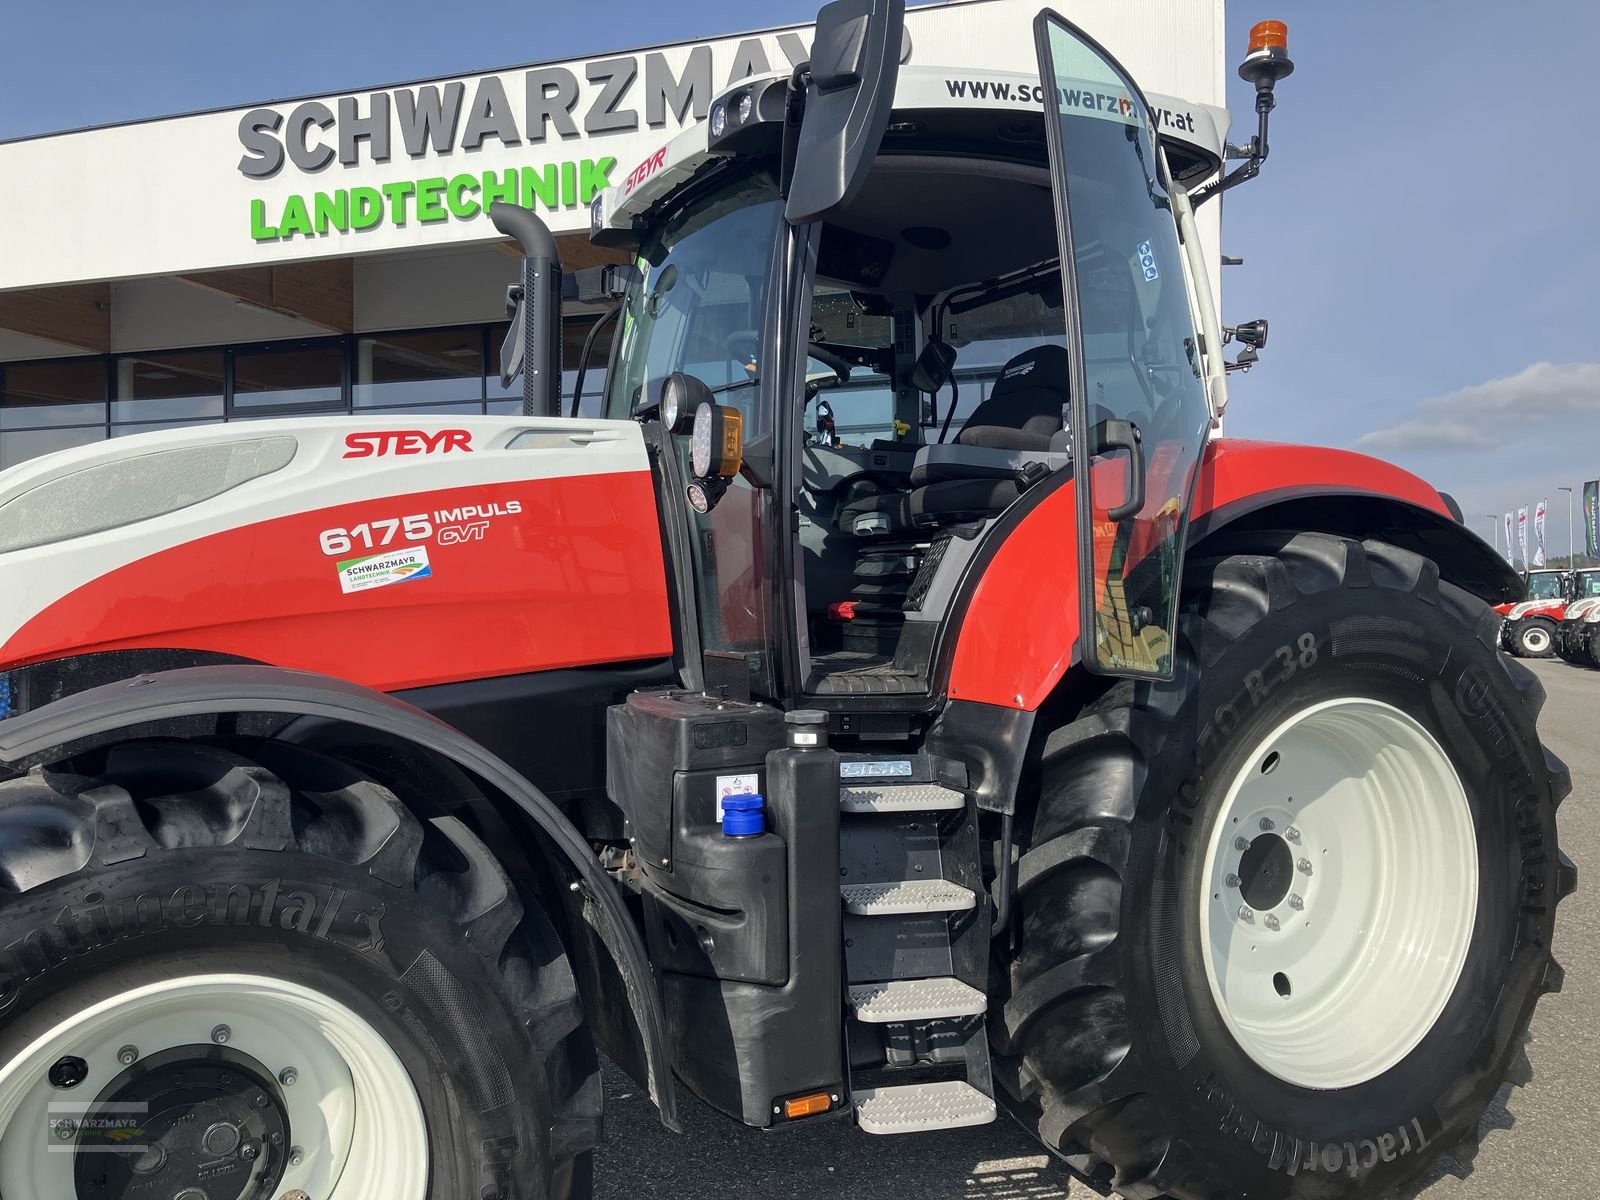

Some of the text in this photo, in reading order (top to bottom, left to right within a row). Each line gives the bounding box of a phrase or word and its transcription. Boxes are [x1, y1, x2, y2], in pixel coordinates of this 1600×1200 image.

[237, 23, 912, 181] SCHWARZMA
[624, 146, 667, 197] STEYR
[251, 155, 617, 242] LANDTECHNIK
[342, 429, 474, 459] STEYR
[319, 500, 523, 557] 6175 IMPULS
[437, 520, 490, 546] CVT
[346, 556, 416, 576] SCHWARZMAYR
[1275, 632, 1318, 682] 38
[0, 877, 348, 1012] ntinental
